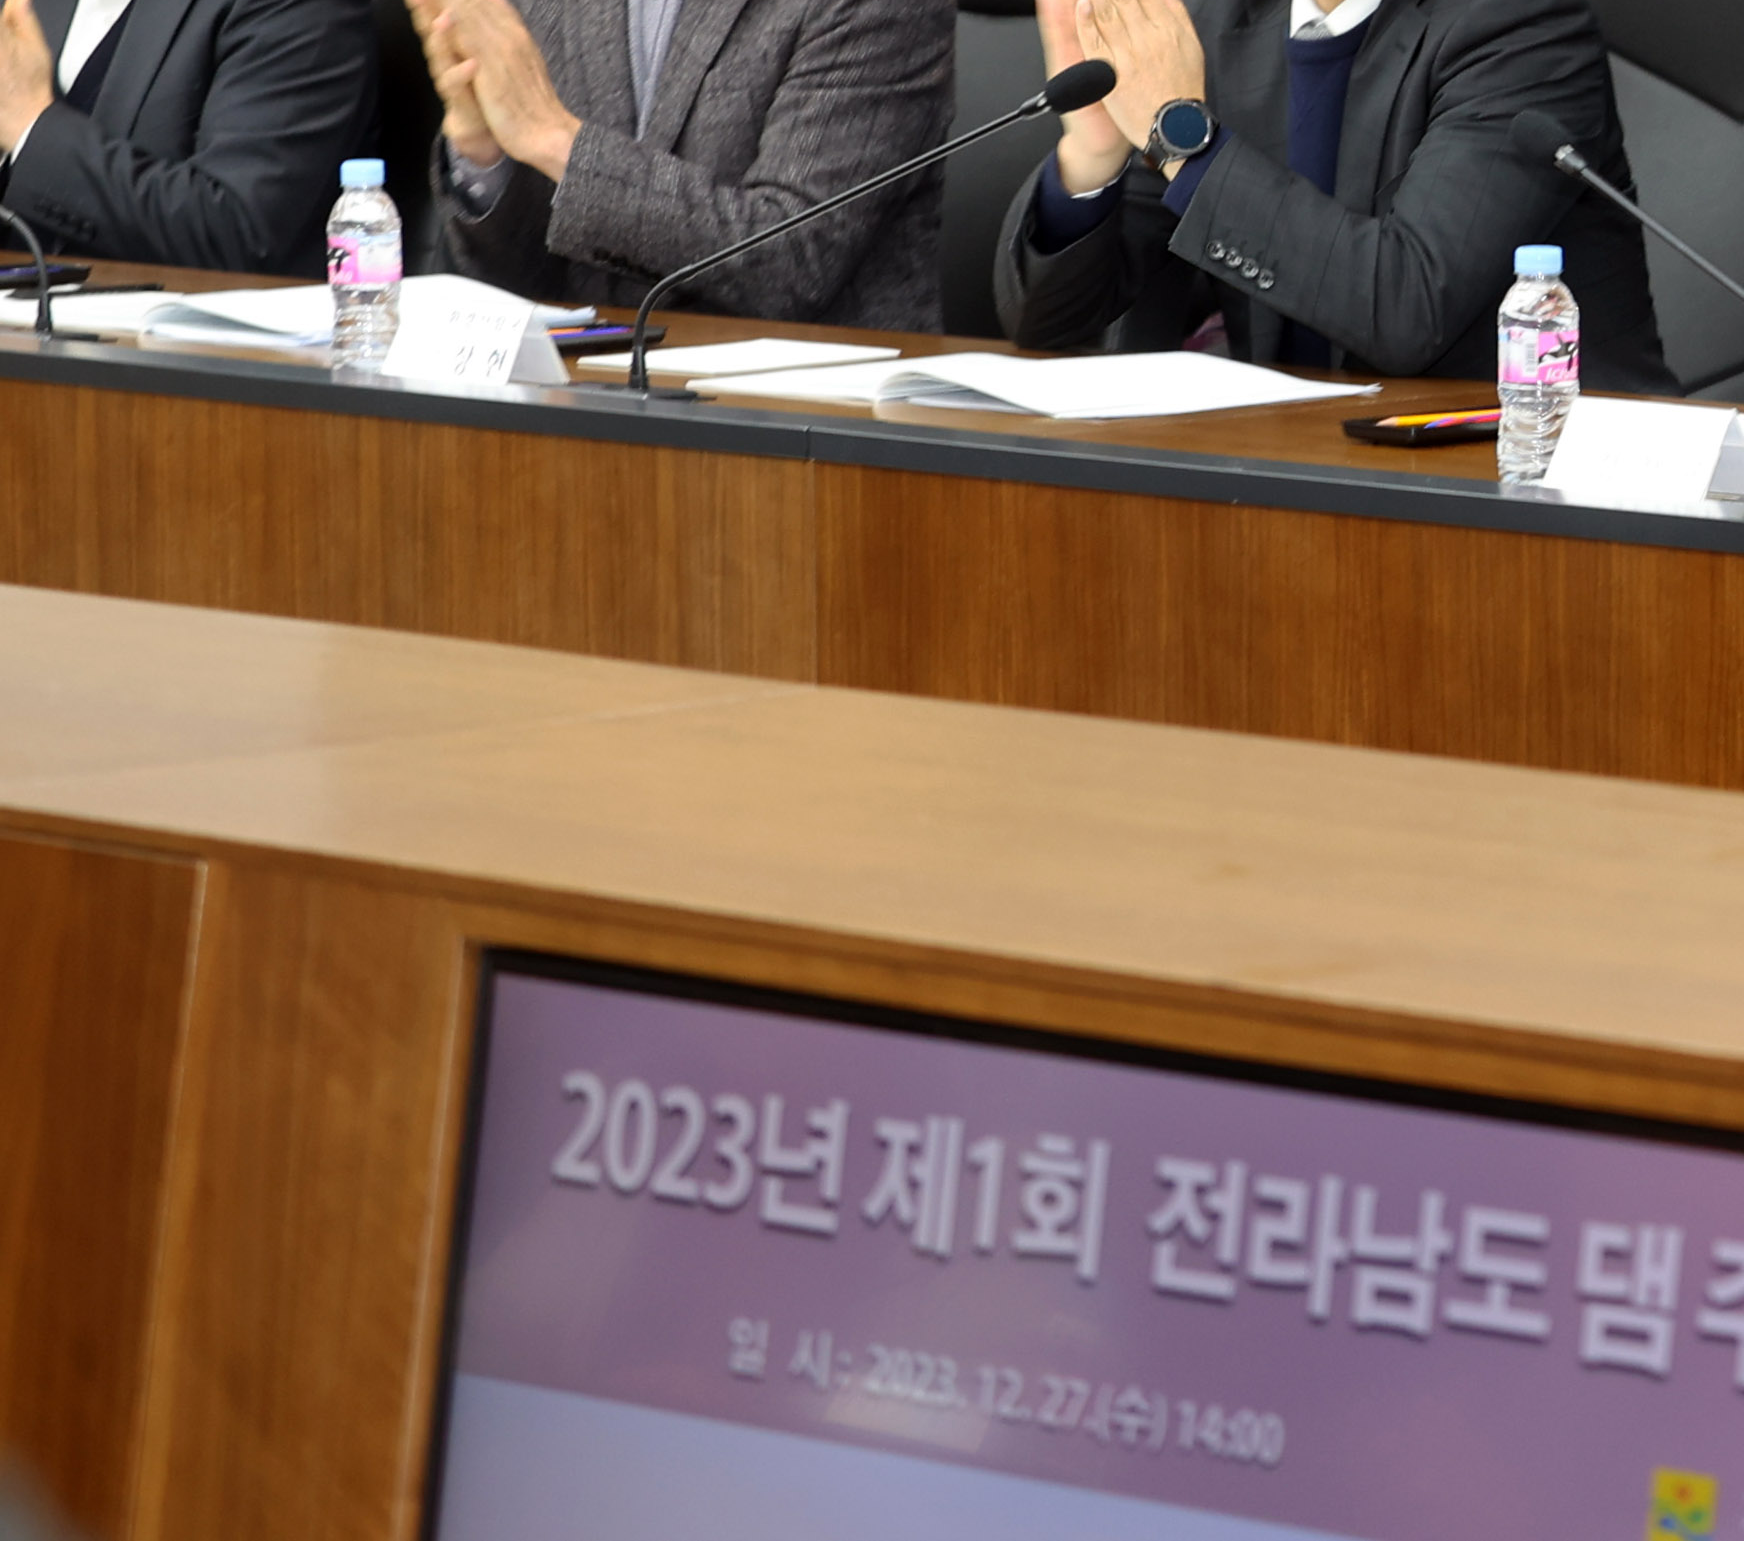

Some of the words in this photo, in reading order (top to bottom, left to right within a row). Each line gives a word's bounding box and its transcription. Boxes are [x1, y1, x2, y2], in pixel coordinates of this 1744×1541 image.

[552, 1072, 848, 1234] 2023년
[862, 1114, 1110, 1282] 제1회
[1147, 1153, 1552, 1340] 전라남도
[1576, 1222, 1684, 1378] 댐
